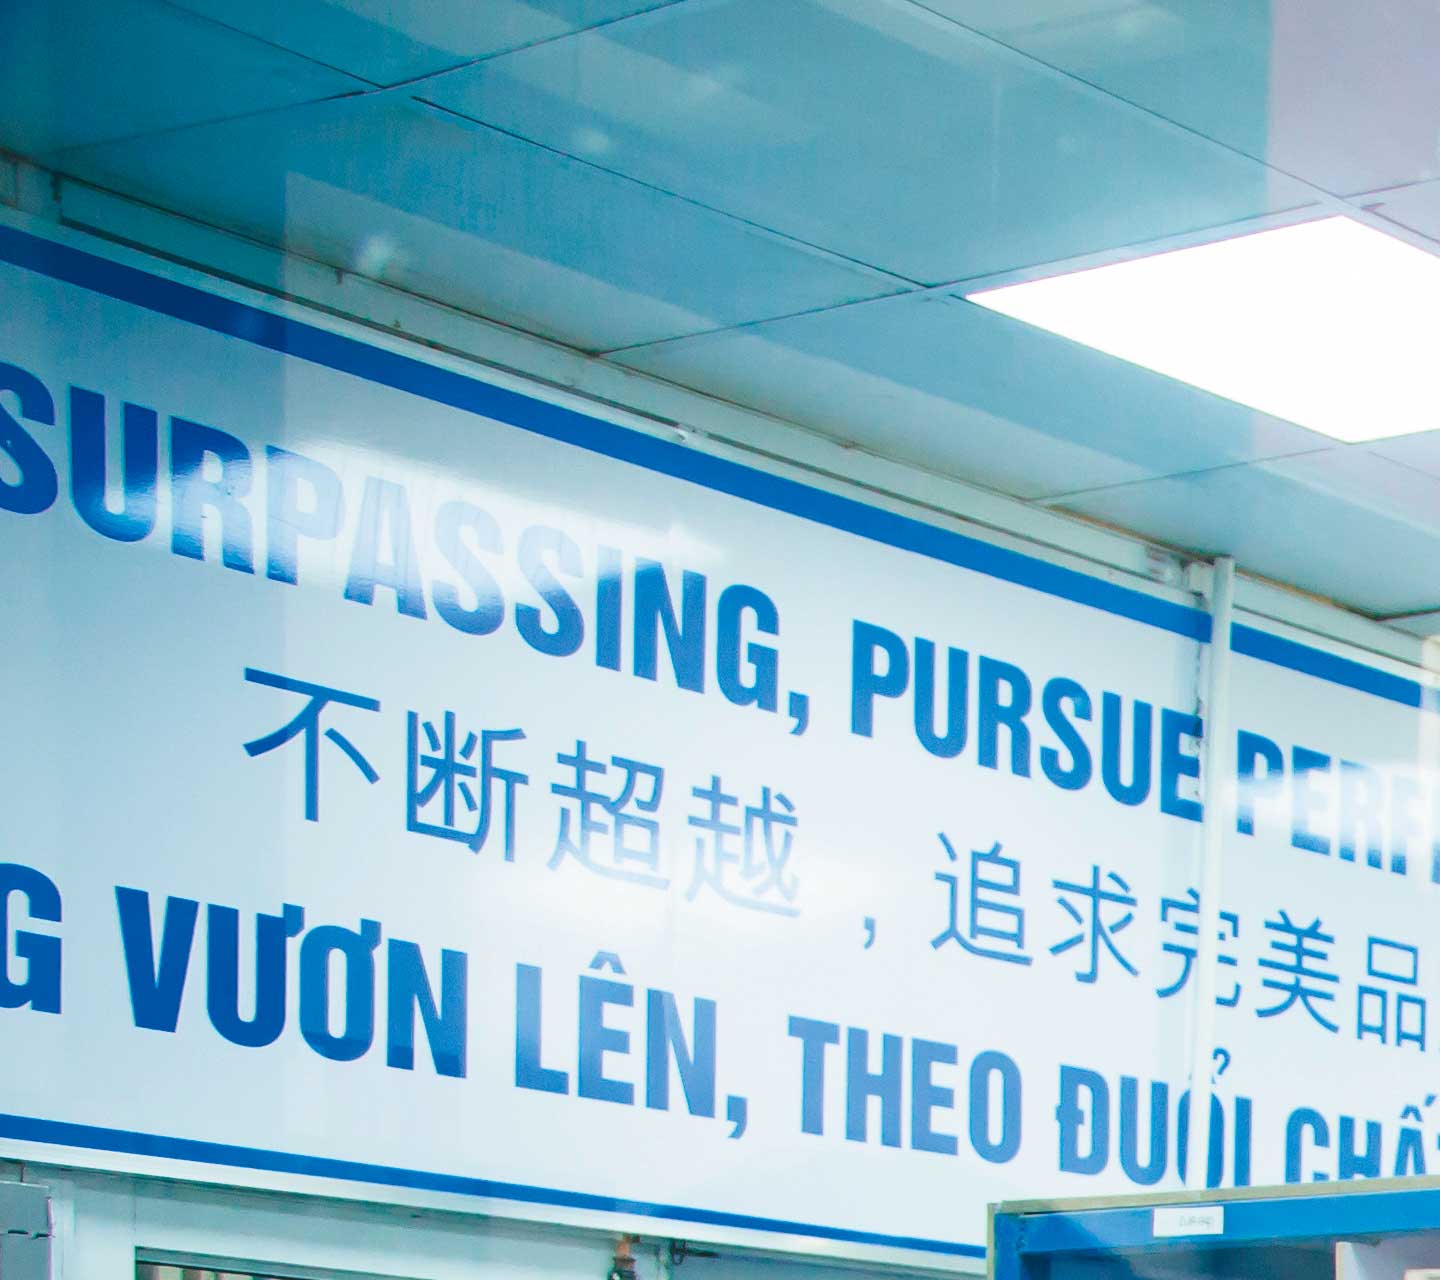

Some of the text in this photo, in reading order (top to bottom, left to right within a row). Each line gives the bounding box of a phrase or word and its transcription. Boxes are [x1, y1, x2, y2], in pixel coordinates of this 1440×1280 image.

[0, 362, 809, 736] SURPASSING,
[850, 618, 1204, 823] PURSUE
[114, 884, 469, 1080] VƯƠN
[514, 948, 750, 1139] LÊN,
[788, 1017, 1023, 1165] THEO
[1055, 1047, 1252, 1189] ĐUỔI
